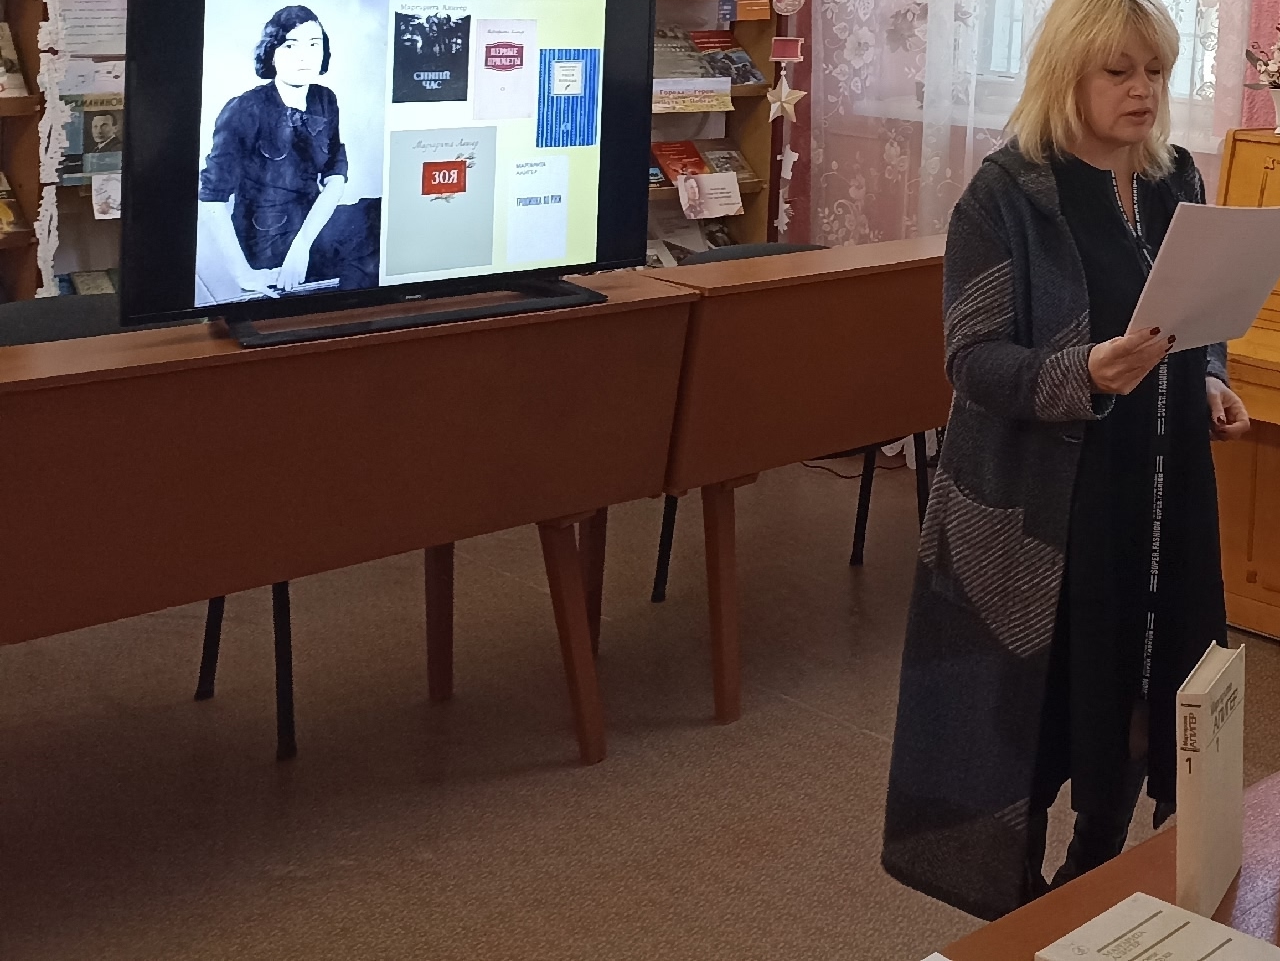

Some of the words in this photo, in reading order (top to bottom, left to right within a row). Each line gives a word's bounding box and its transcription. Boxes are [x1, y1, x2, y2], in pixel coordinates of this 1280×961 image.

[422, 80, 442, 90] ЧАС
[431, 169, 458, 185] ЗОЯ
[1189, 712, 1197, 750] АЛИГЕР
[1185, 757, 1192, 775] 1
